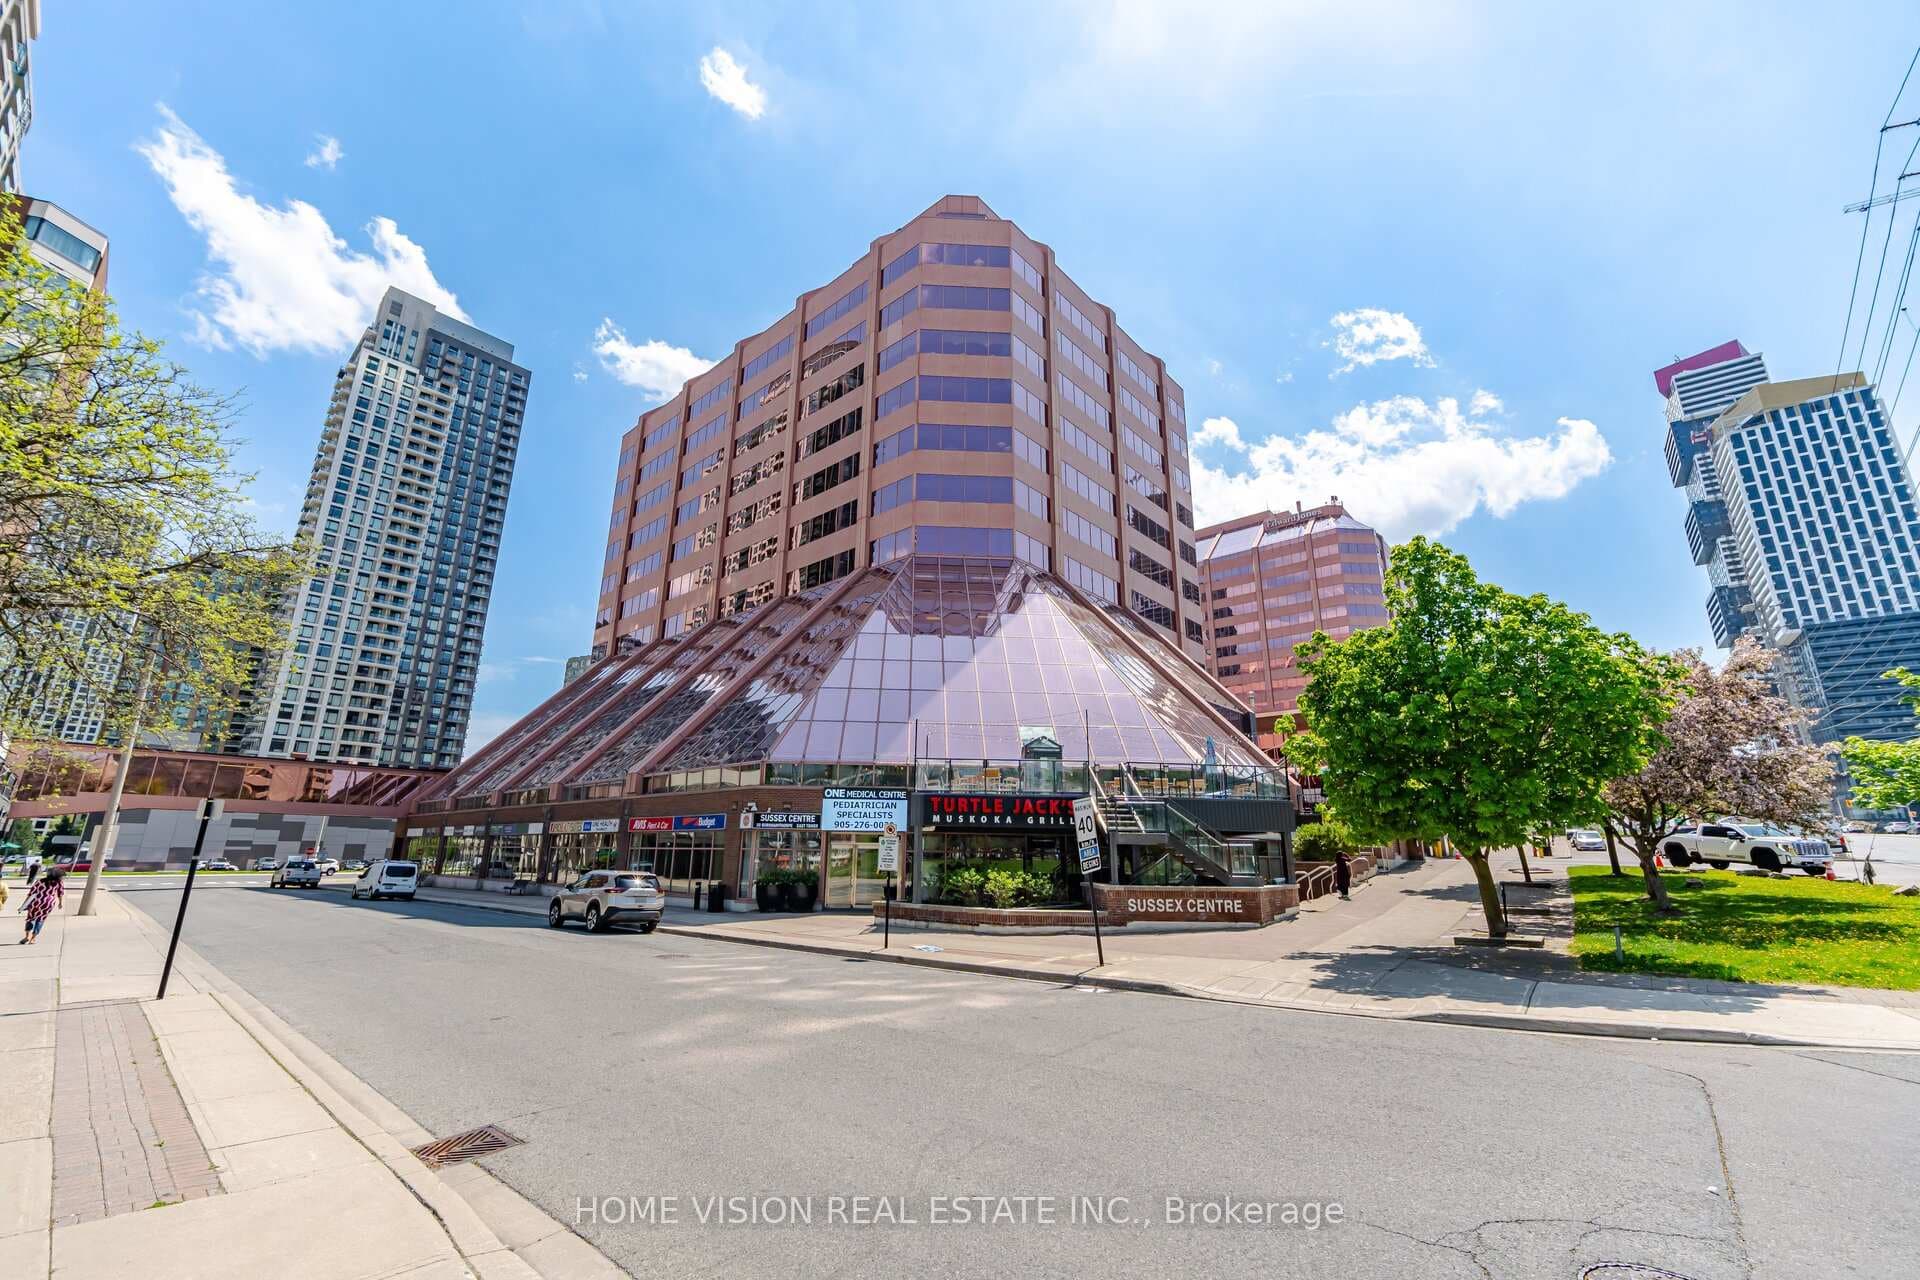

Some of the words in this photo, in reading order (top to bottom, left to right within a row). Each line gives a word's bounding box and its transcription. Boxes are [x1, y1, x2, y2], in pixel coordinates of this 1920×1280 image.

[824, 788, 846, 798] ONE
[846, 790, 878, 798] MEDICAL
[878, 791, 907, 799] CENTRE
[833, 801, 897, 809] PEDIATRICIAN
[930, 797, 1004, 814] TURTLE
[1012, 799, 1074, 816] JACK'S
[760, 814, 788, 823] SUSSEX
[788, 814, 816, 823] CENTRE
[836, 811, 894, 819] SPECIALISTS
[932, 815, 1012, 824] MUSKOKA
[1026, 816, 1075, 825] GRILL
[632, 819, 648, 830] AVIS
[698, 817, 716, 828] Budget
[833, 821, 895, 829] 905-276-00
[1078, 815, 1093, 834] 40
[1127, 899, 1184, 912] SUSSEX
[1186, 899, 1243, 913] CENTRE
